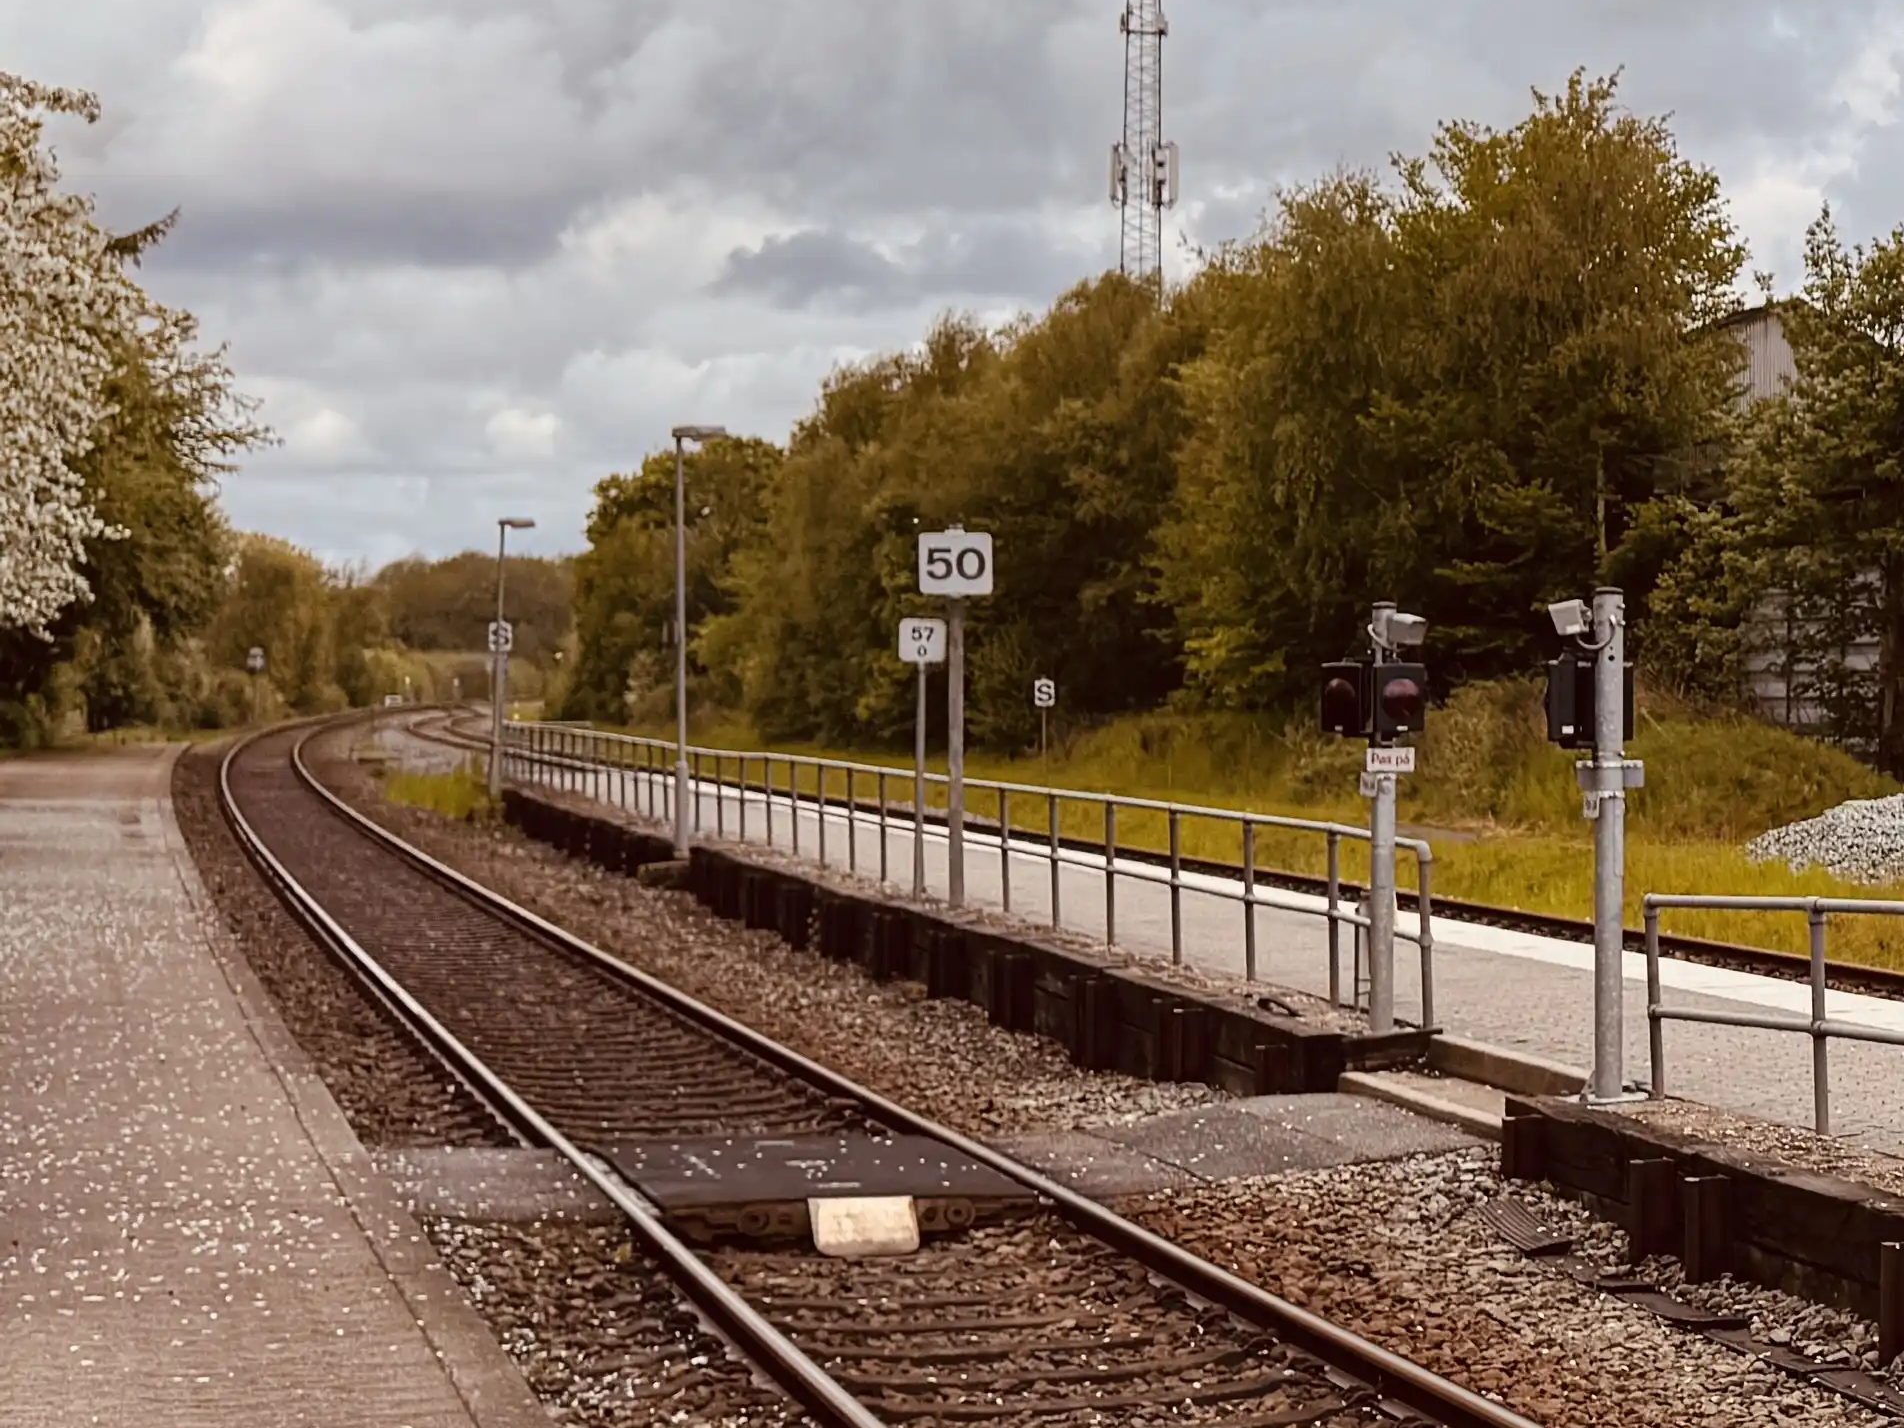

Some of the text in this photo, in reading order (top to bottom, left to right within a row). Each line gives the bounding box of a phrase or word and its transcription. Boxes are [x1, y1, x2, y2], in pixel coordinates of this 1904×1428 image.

[926, 547, 986, 580] 50
[911, 626, 934, 642] 57
[917, 644, 927, 658] 0
[1037, 683, 1052, 702] S
